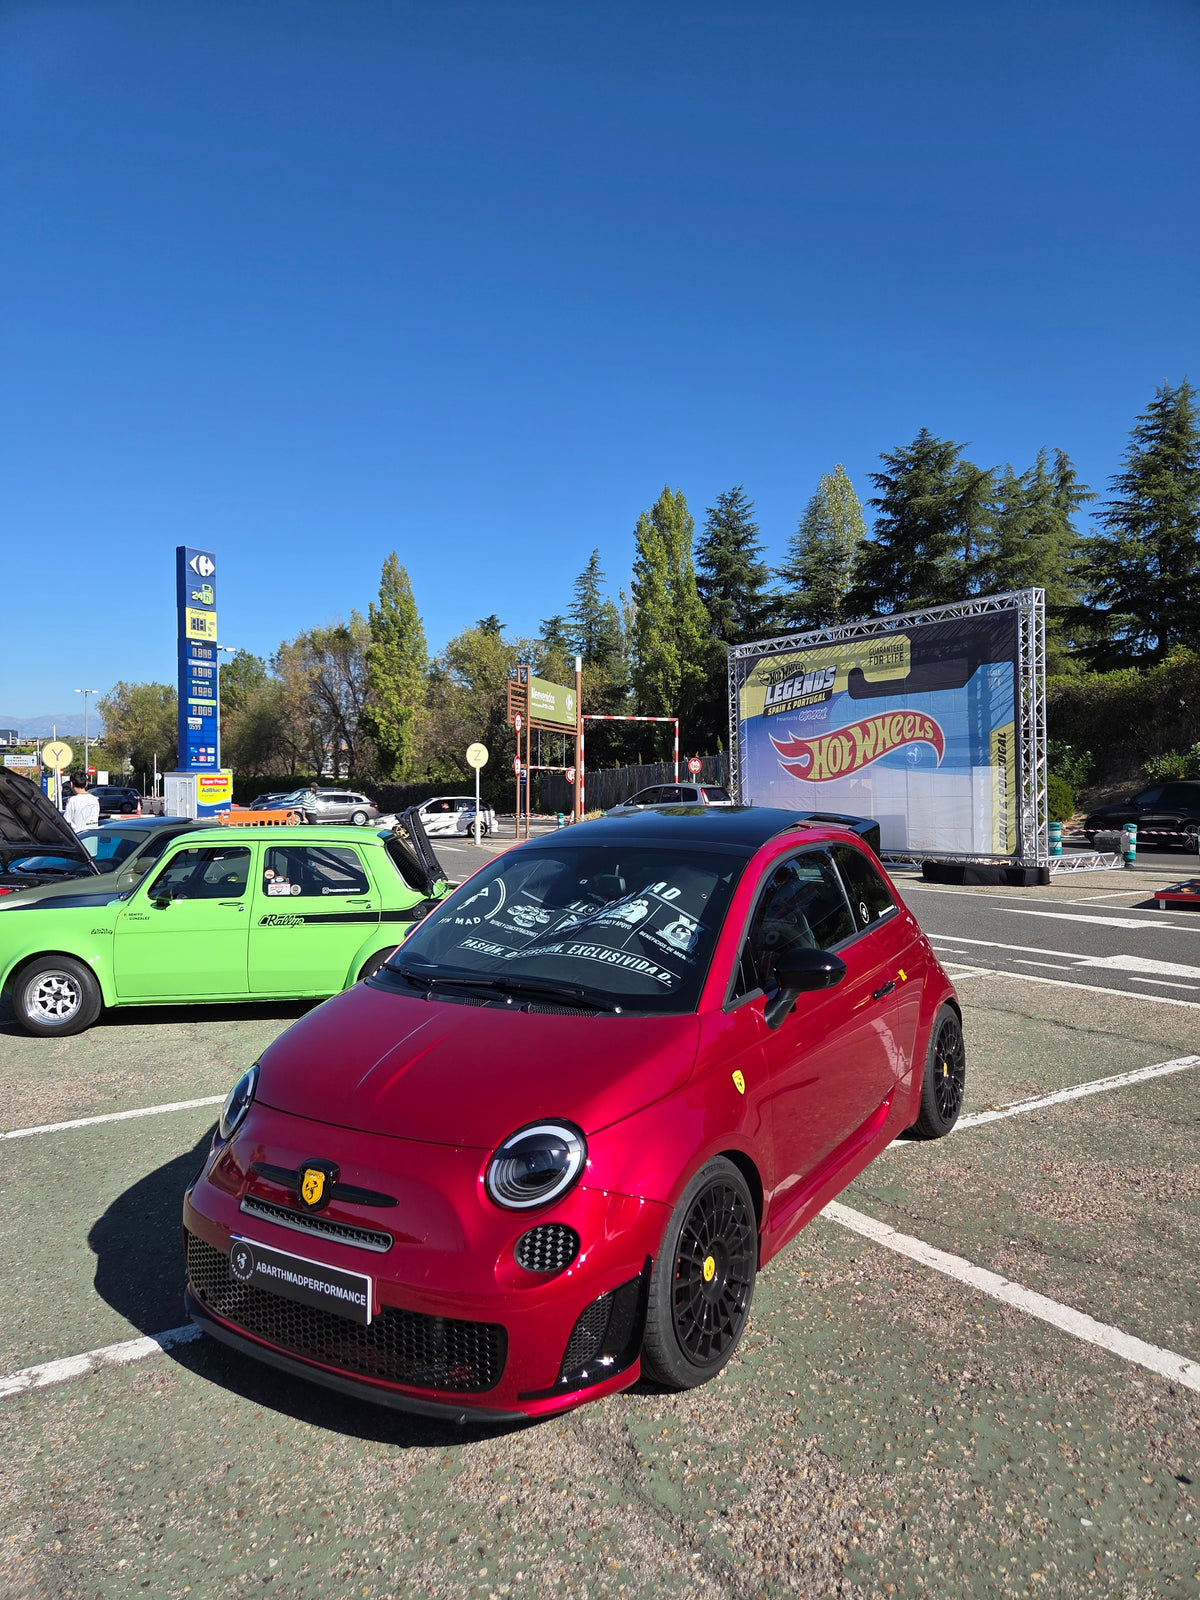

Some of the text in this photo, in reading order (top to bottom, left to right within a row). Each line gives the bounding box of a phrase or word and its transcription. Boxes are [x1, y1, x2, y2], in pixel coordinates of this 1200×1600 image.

[868, 643, 904, 656] GUARANTEED
[869, 652, 904, 665] FOR LIFE
[765, 665, 837, 706] LEGENDS
[767, 704, 786, 716] SPAIN
[792, 692, 826, 709] PORTUGAL
[51, 749, 63, 762] Y
[473, 749, 482, 761] Z
[454, 916, 481, 926] MAD
[255, 1261, 367, 1306] ABARTHMADPERFORMANCE
